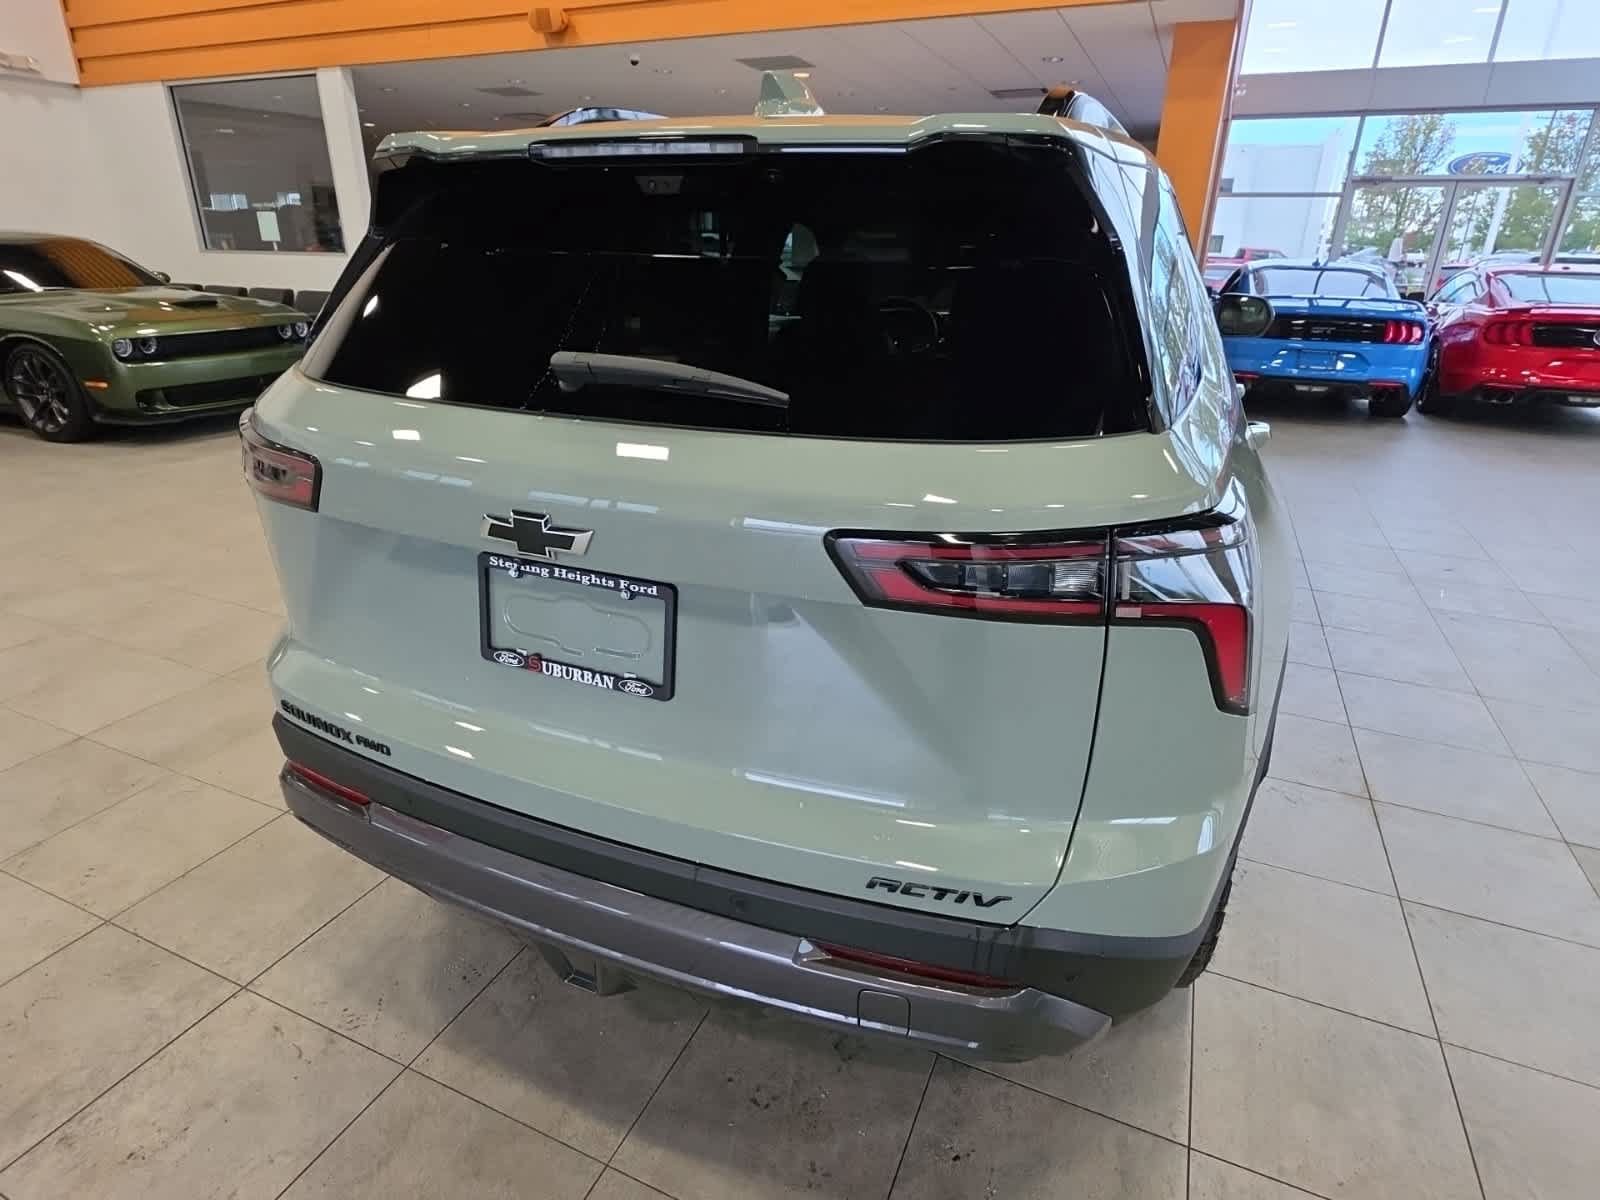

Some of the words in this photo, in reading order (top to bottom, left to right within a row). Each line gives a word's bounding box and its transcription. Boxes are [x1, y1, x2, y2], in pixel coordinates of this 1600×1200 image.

[489, 555, 550, 578] Steing
[553, 567, 615, 588] Heights
[619, 579, 658, 596] Ford
[527, 655, 615, 689] SUBURBAN
[280, 699, 354, 745] EQUINOX
[355, 734, 392, 756] AWD
[865, 876, 1013, 908] ACTIV
